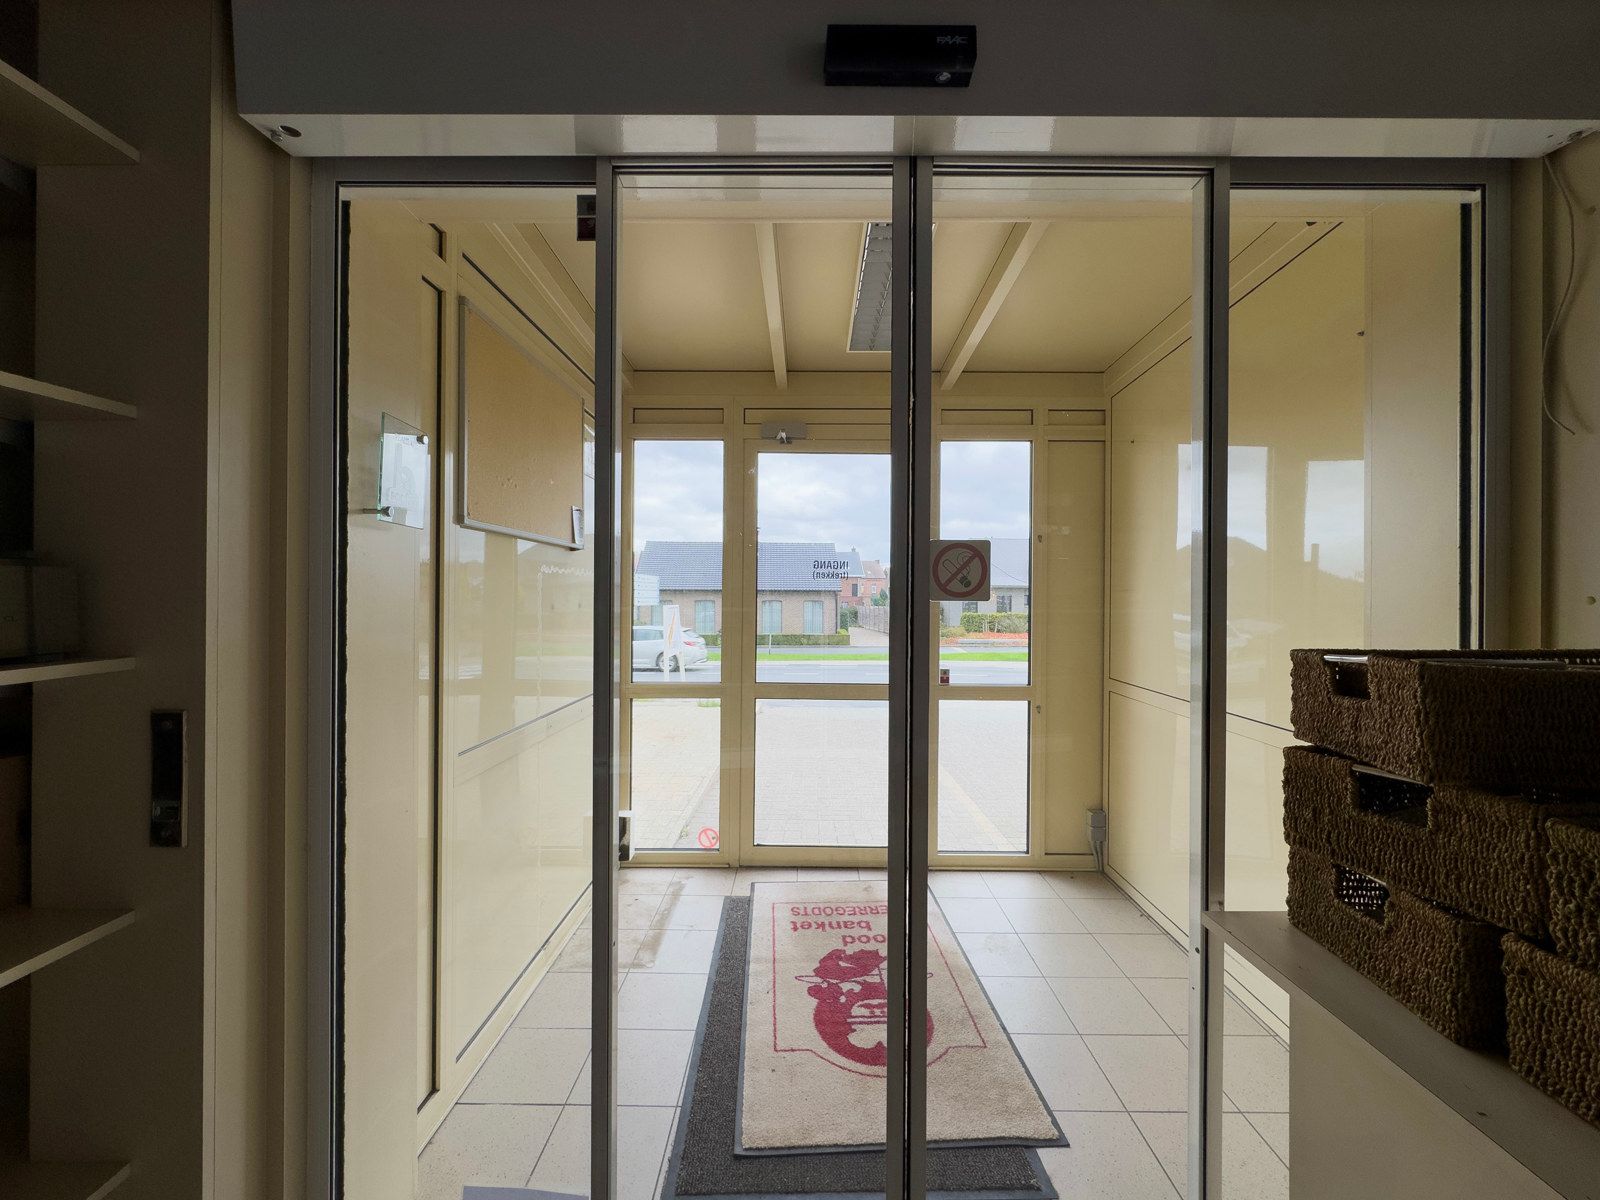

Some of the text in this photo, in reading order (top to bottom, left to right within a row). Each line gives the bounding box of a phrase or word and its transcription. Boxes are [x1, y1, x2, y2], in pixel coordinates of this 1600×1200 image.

[790, 905, 888, 917] ERREGODTS
[790, 920, 872, 933] banket
[841, 934, 887, 947] ood
